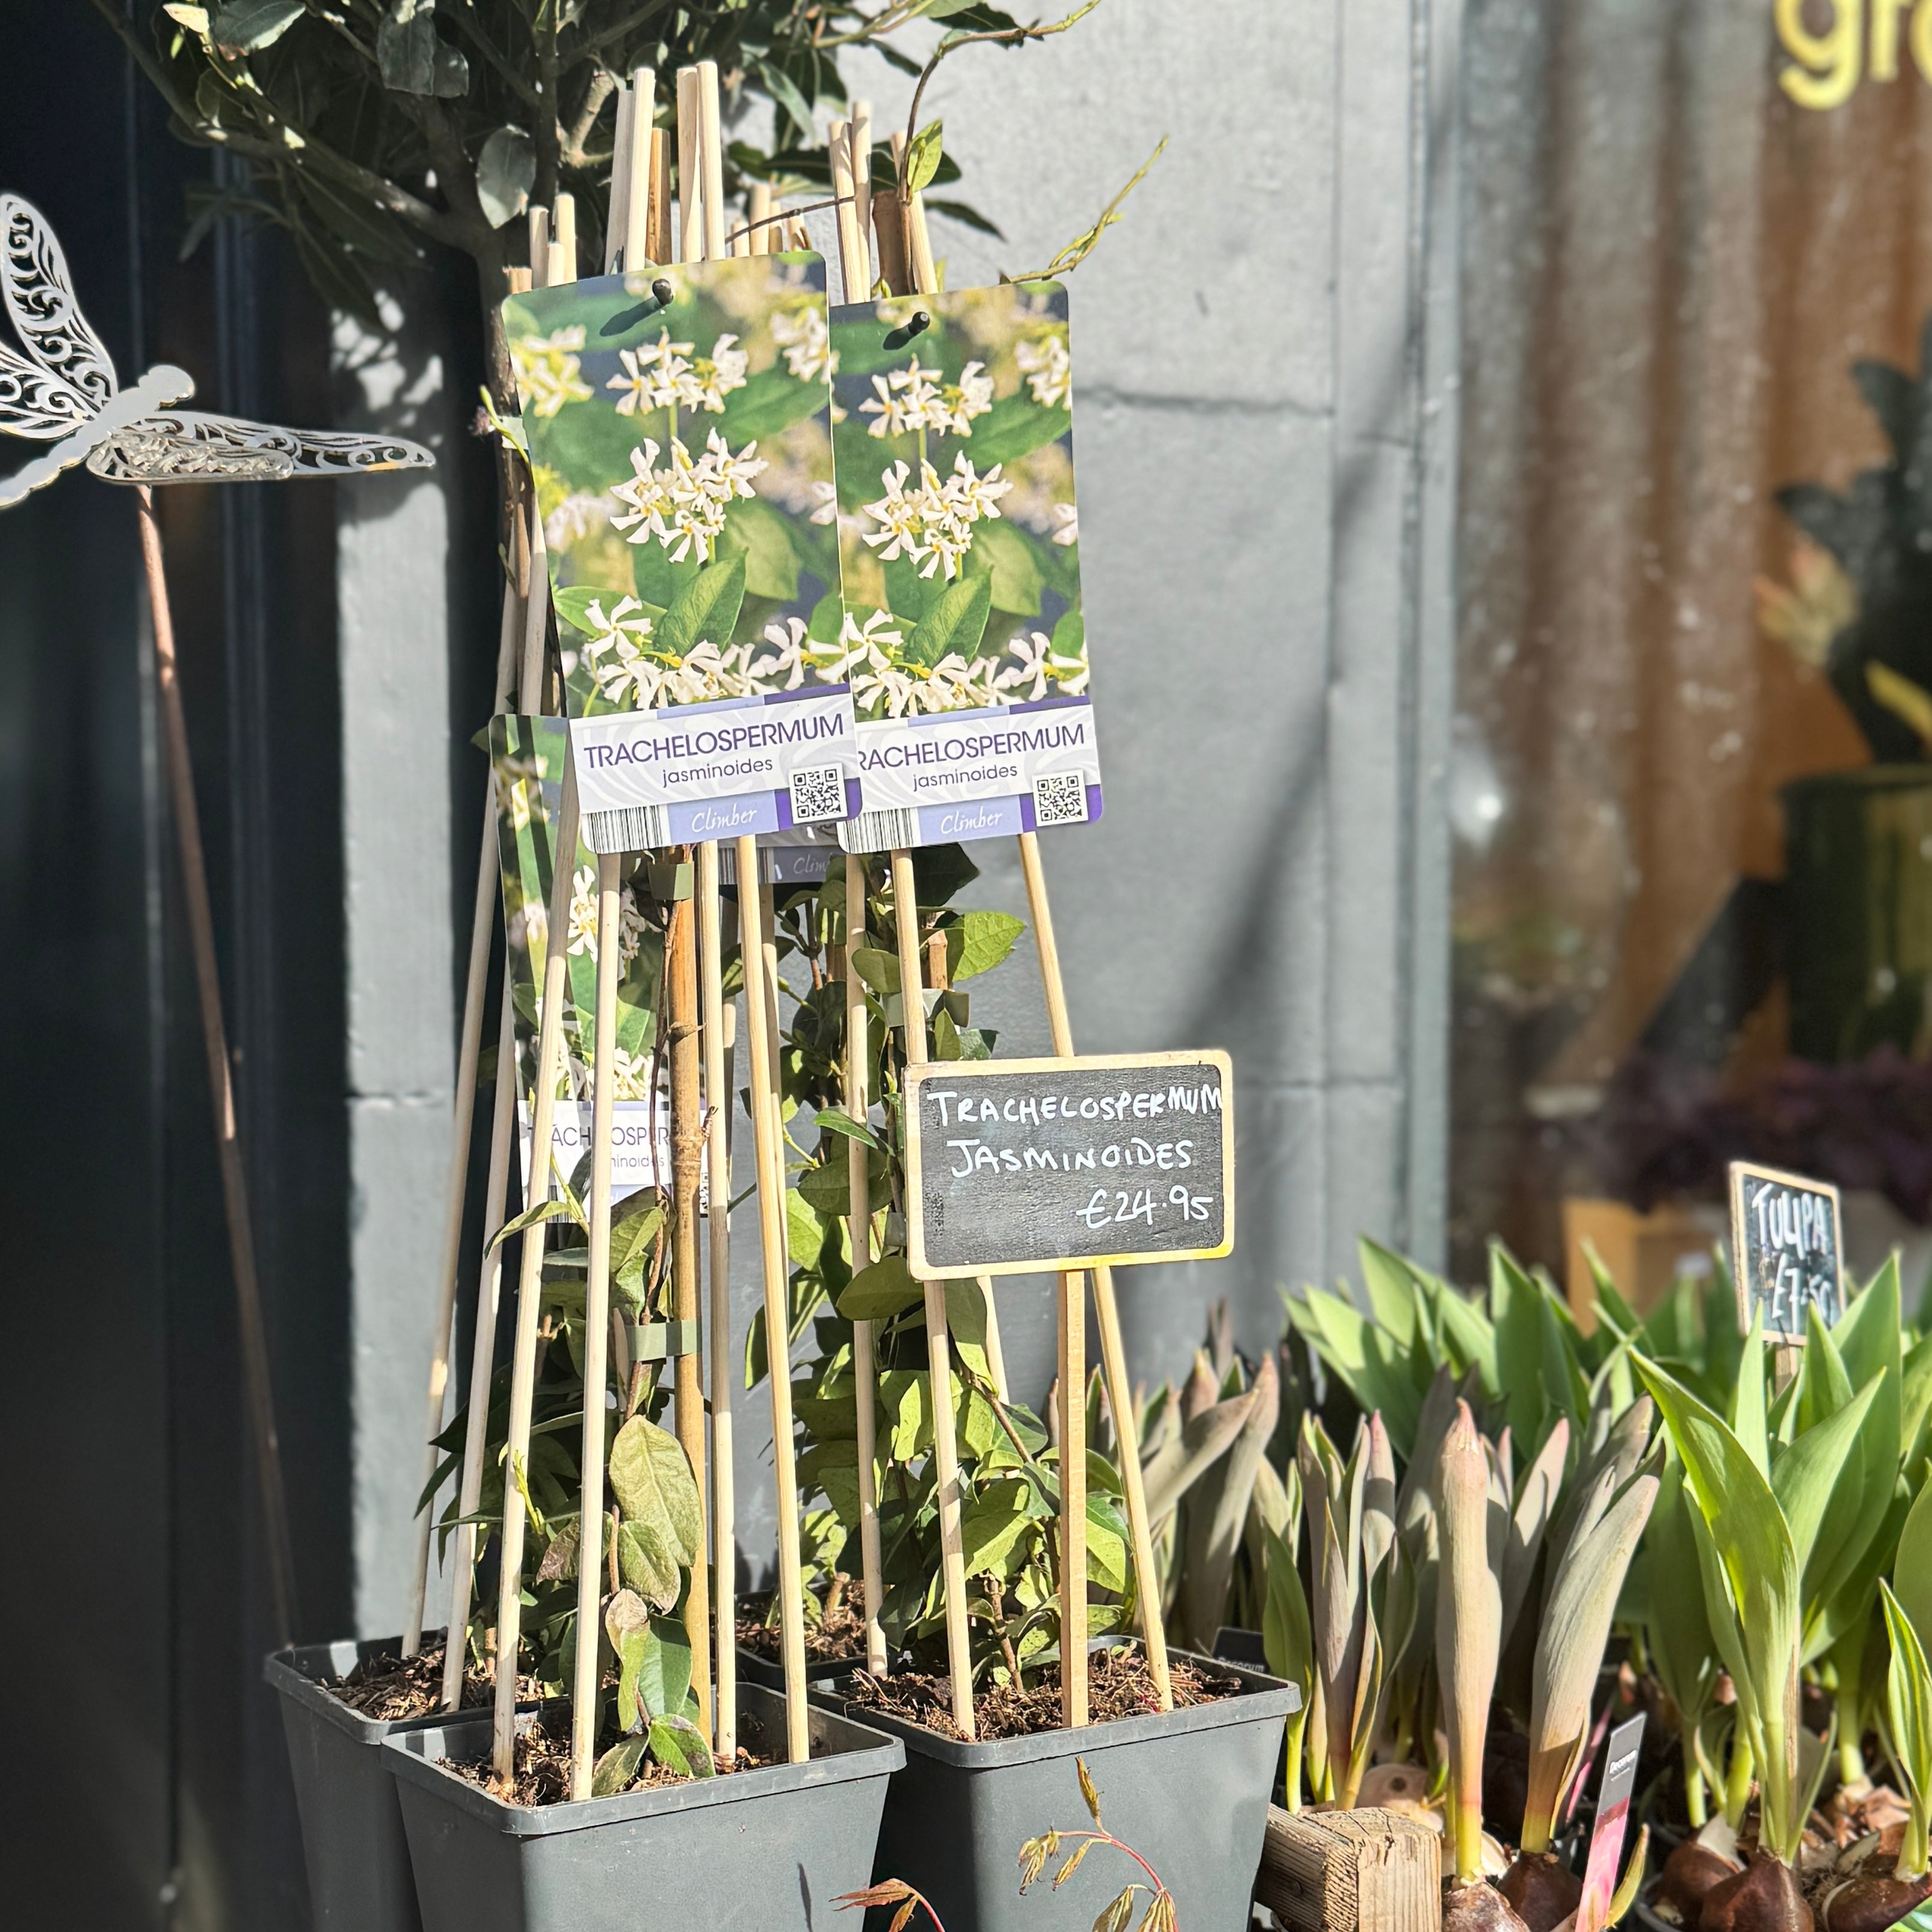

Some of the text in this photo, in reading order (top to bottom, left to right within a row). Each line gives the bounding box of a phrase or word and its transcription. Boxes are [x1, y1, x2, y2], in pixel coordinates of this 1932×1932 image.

[1773, 0, 1932, 110] gr
[584, 713, 844, 768] TRACHELOSPERMUM
[858, 724, 1084, 771] RACHELOSPERMUM
[662, 758, 773, 788] jasminoides
[913, 765, 1018, 792] jasminoides
[691, 802, 758, 833] Climber
[941, 806, 1003, 835] Climber
[793, 851, 833, 875] Clim
[927, 1083, 1223, 1128] TRACHELOSPERMUM
[947, 1137, 1193, 1178] JASMINOIDES
